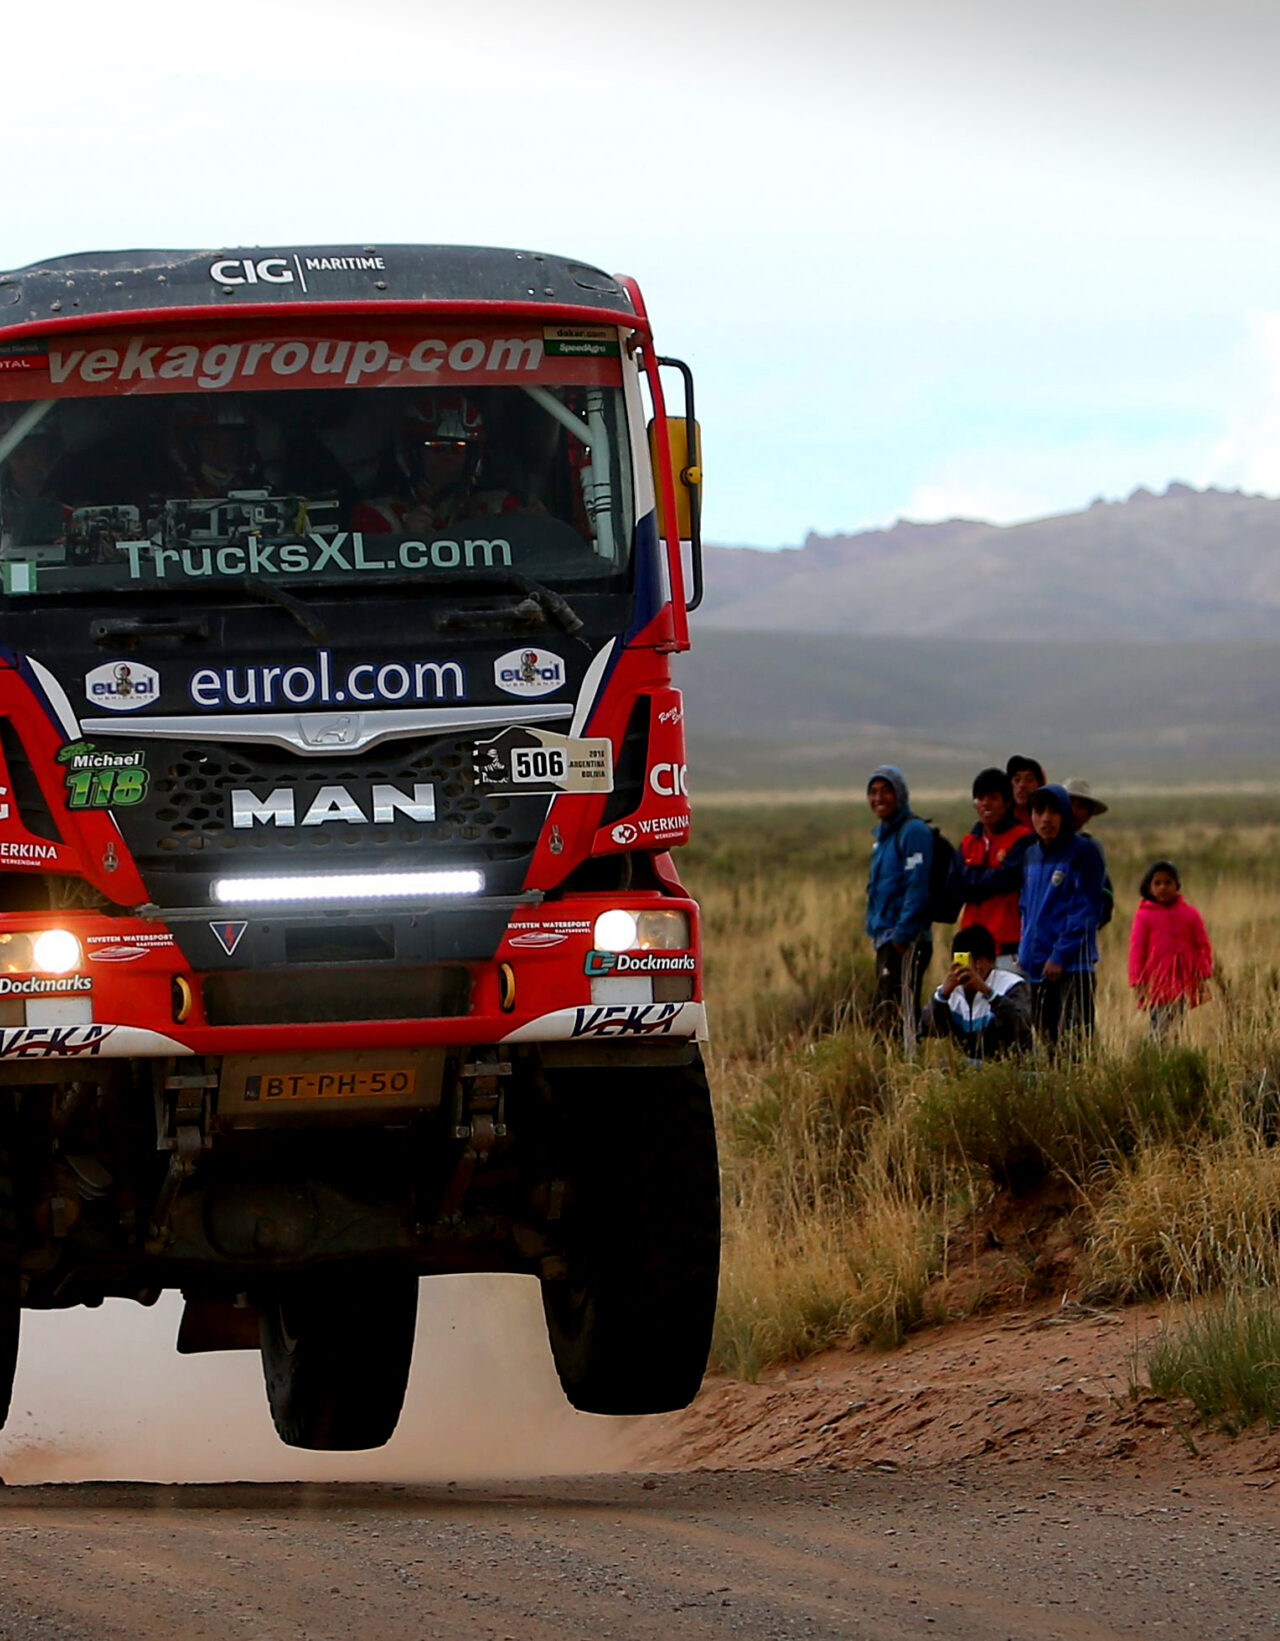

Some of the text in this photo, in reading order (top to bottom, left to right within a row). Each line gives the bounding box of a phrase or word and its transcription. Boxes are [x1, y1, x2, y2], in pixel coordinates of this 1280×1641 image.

[209, 256, 386, 285] CIG MARITIME
[48, 336, 543, 388] vekagroup.com
[559, 343, 607, 354] SpeedAgro
[116, 532, 513, 579] TrucksXL.com
[92, 676, 155, 696] euol
[191, 650, 464, 706] eurol.com
[73, 753, 140, 768] Michael
[516, 750, 564, 779] 506
[67, 767, 148, 808] 118
[231, 783, 436, 829] MAN
[123, 933, 174, 942] WATERSPORT
[542, 920, 591, 928] WATERSPORT
[617, 954, 695, 971] Dockmarks
[571, 1002, 682, 1038] VEKA
[267, 1071, 409, 1097] BT-PH-50
